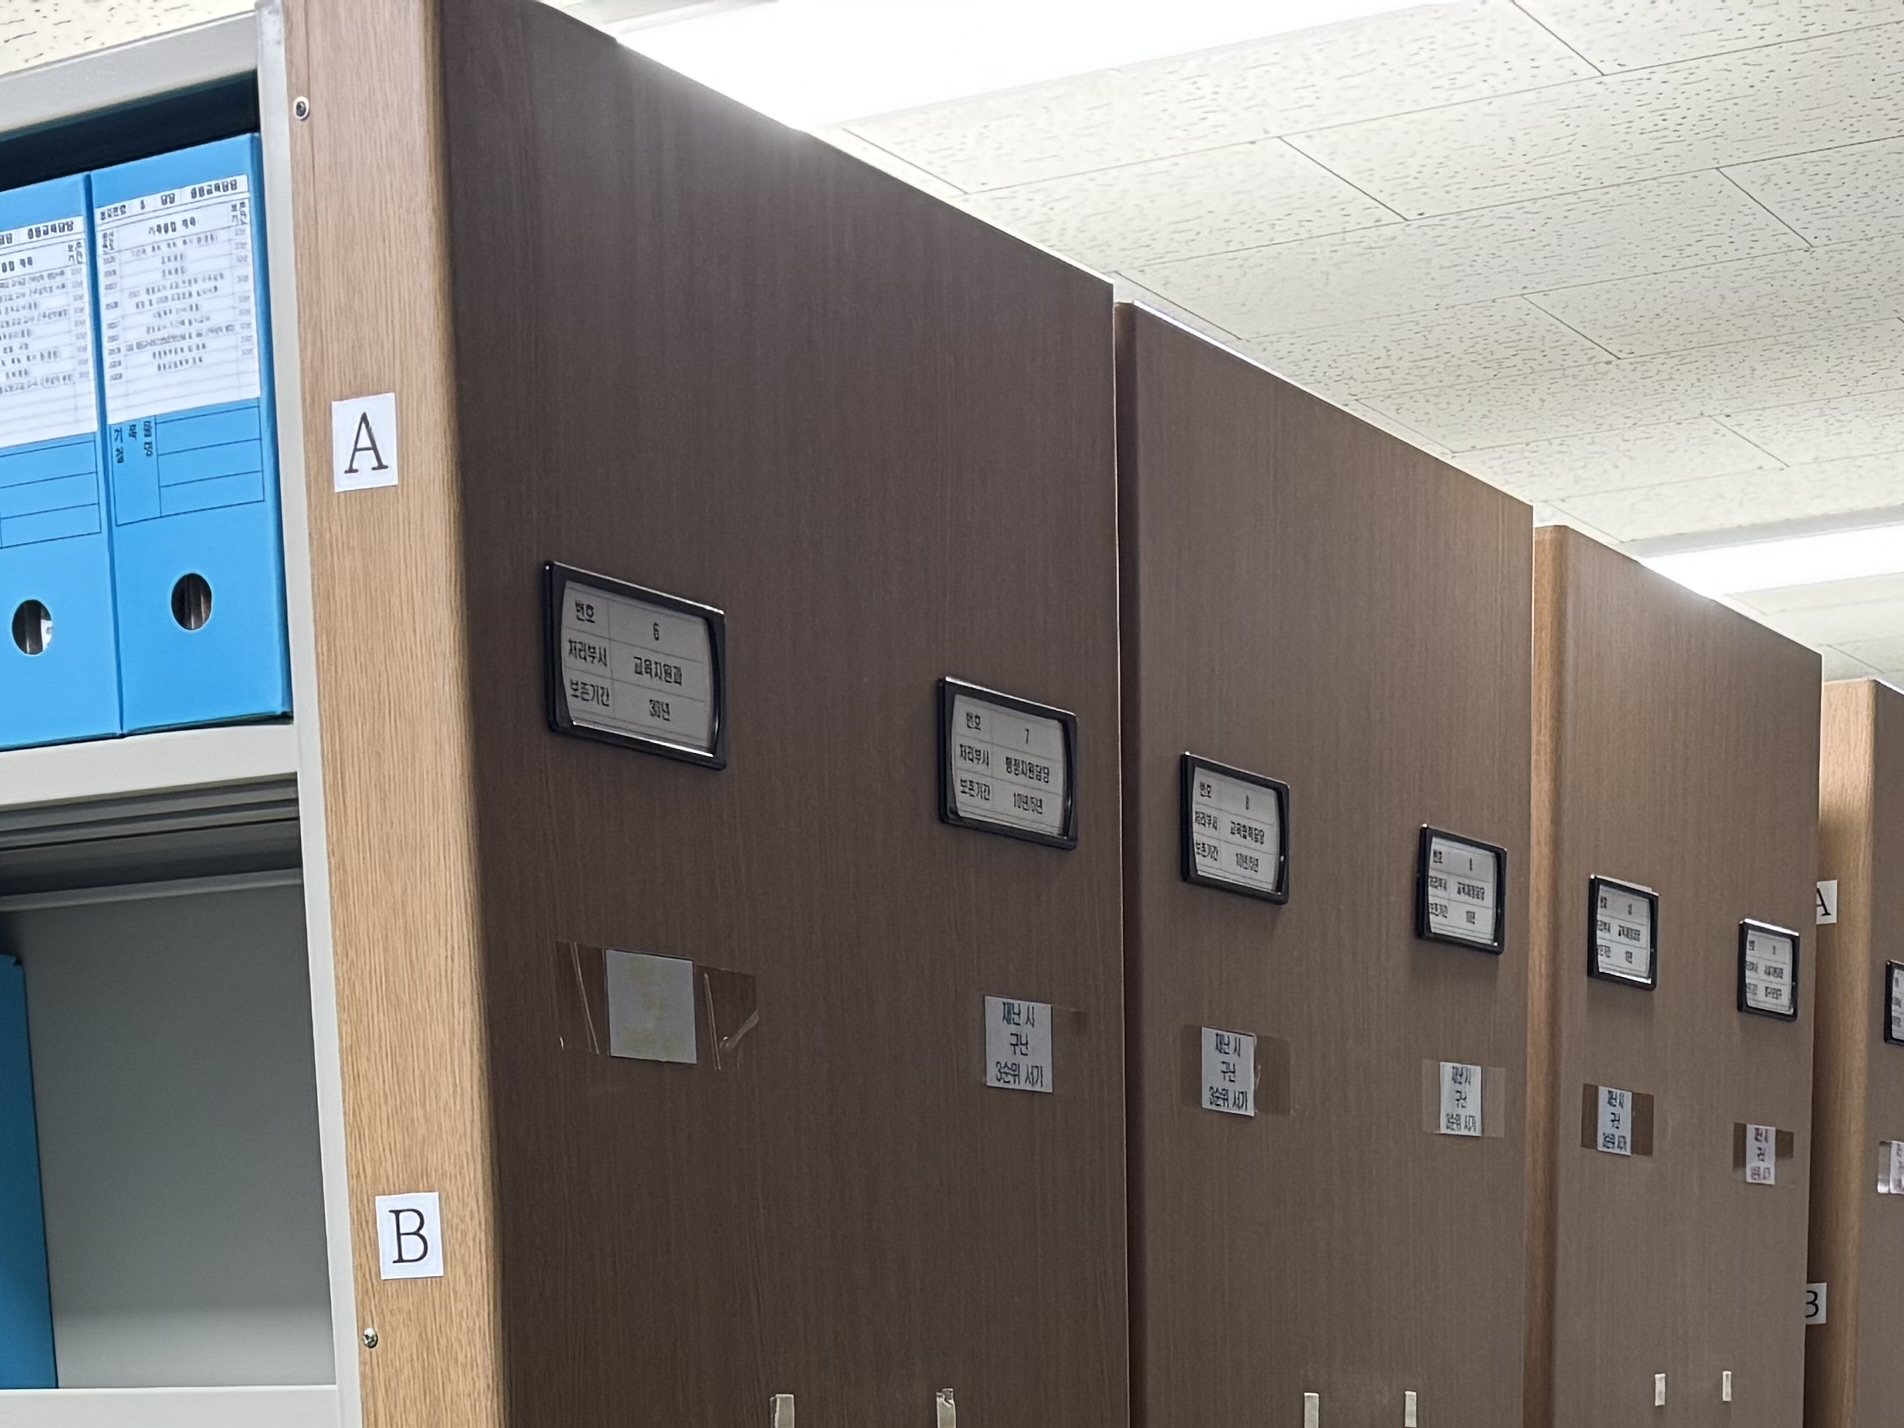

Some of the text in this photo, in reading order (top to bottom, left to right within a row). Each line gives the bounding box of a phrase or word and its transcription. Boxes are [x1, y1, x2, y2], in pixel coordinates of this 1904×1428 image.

[344, 411, 388, 474] A
[575, 600, 595, 624] 번호
[568, 639, 683, 686] 처리부서 교육지원과
[570, 679, 671, 721] 보존기간 30년
[966, 711, 982, 731] 번호
[959, 743, 1050, 784] 처리부서 행정지원담당
[960, 777, 991, 801] 보존기간
[1002, 1002, 1035, 1028] 재난 시
[1009, 1032, 1029, 1056] 구난
[996, 1061, 1043, 1088] 3순위 서가
[1221, 1061, 1236, 1083] 구난
[388, 1208, 429, 1264] B
